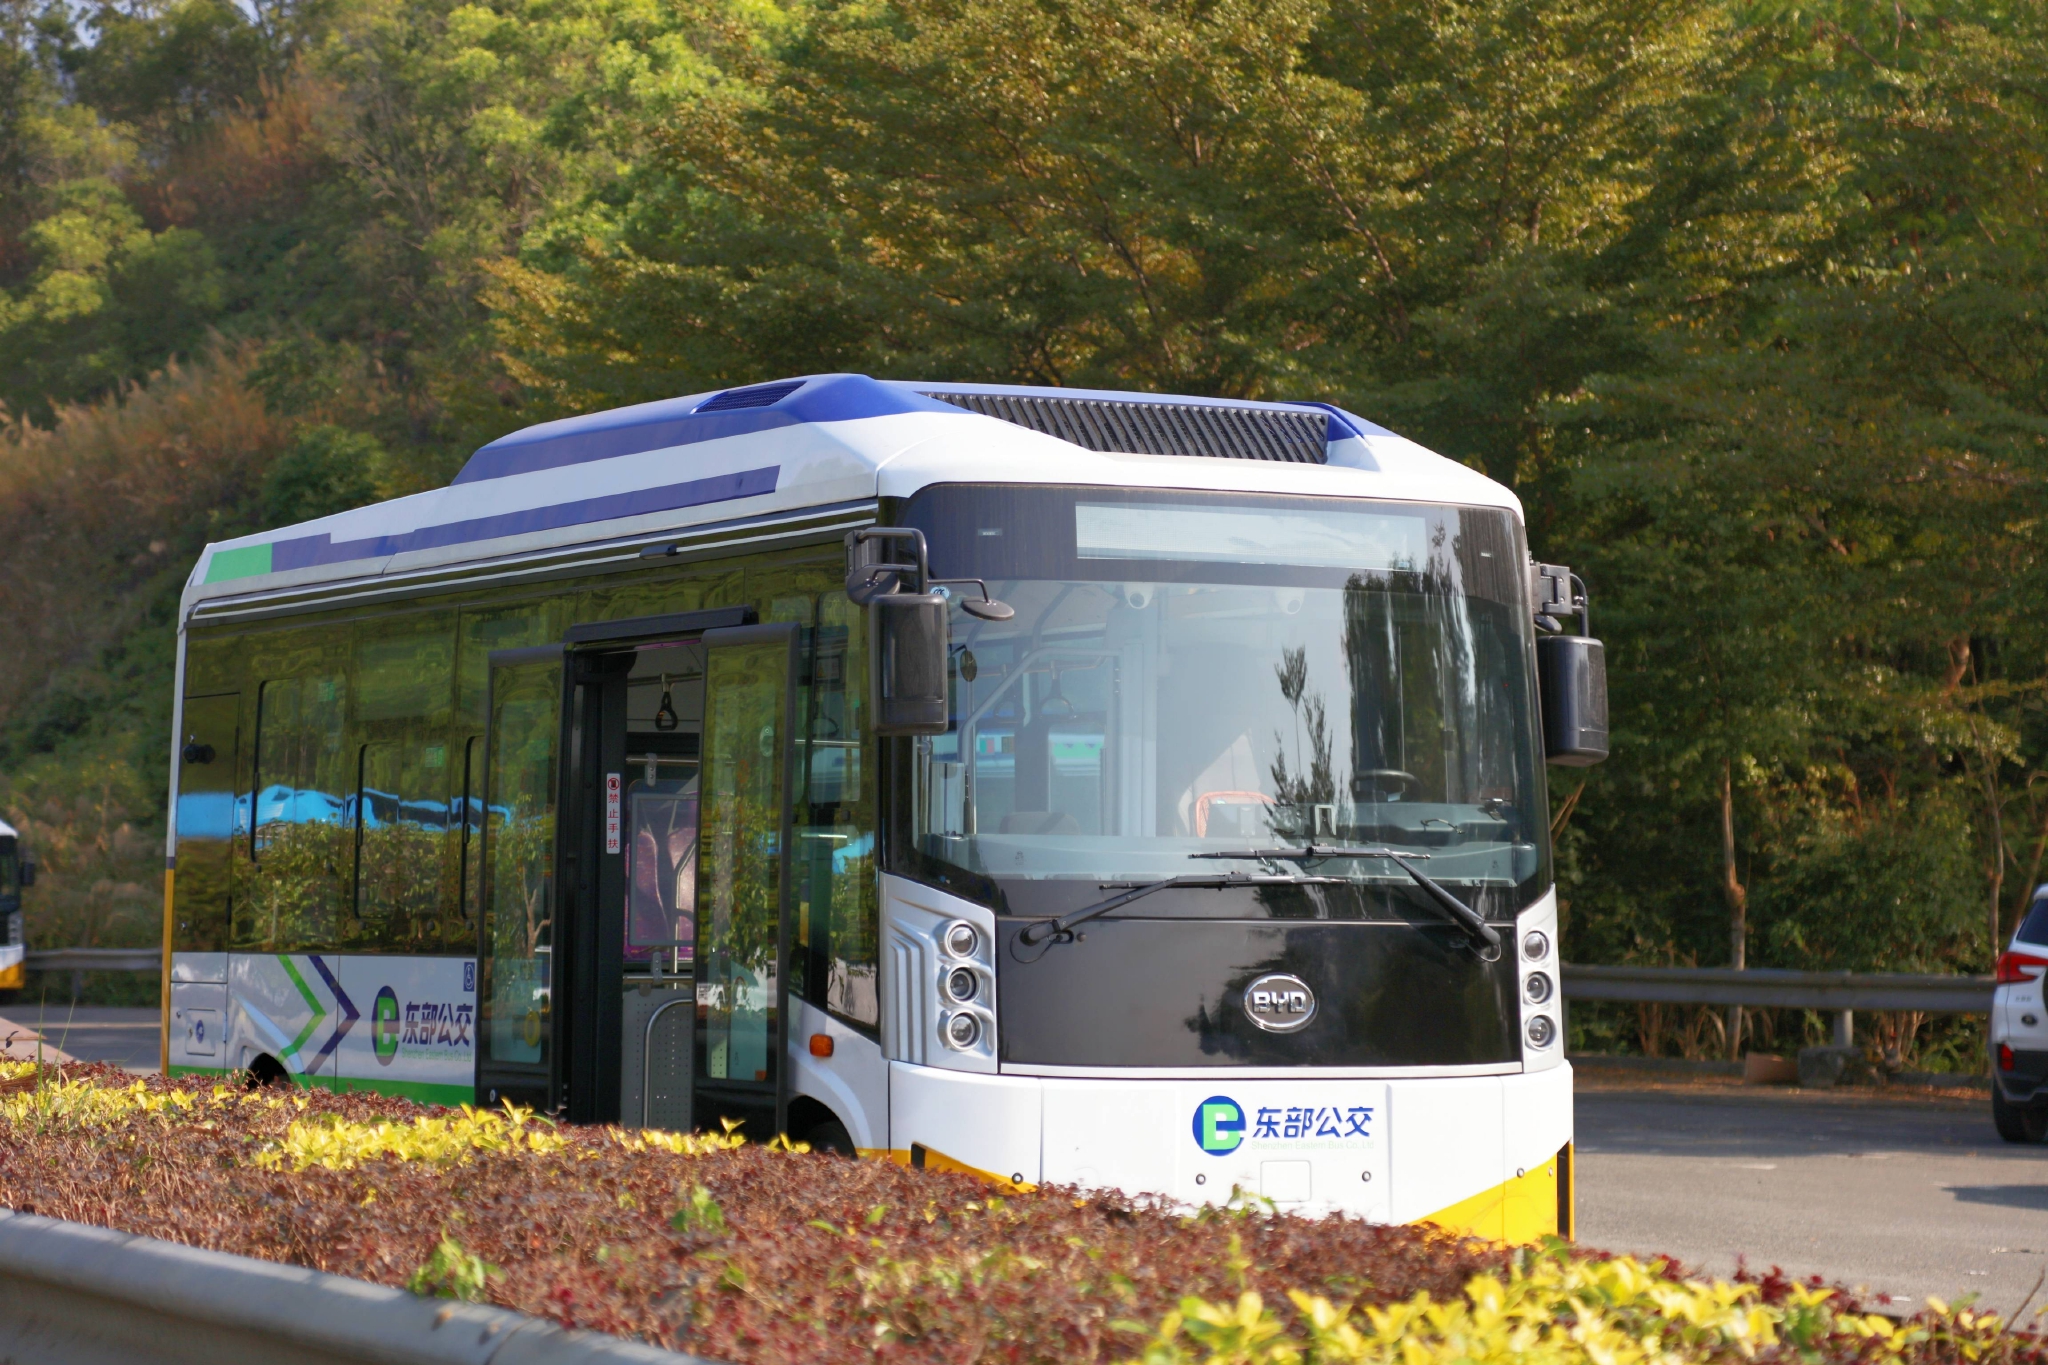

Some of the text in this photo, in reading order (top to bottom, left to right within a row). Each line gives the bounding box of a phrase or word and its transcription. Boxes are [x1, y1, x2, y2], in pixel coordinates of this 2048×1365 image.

[607, 792, 620, 849] 禁止手扶
[1252, 991, 1306, 1014] BYD
[402, 1001, 473, 1047] 东部公交
[1252, 1106, 1374, 1138] 东部公交
[1251, 1140, 1292, 1150] Shenzhen
[1295, 1140, 1326, 1150] Eastern
[1328, 1140, 1344, 1149] Bus
